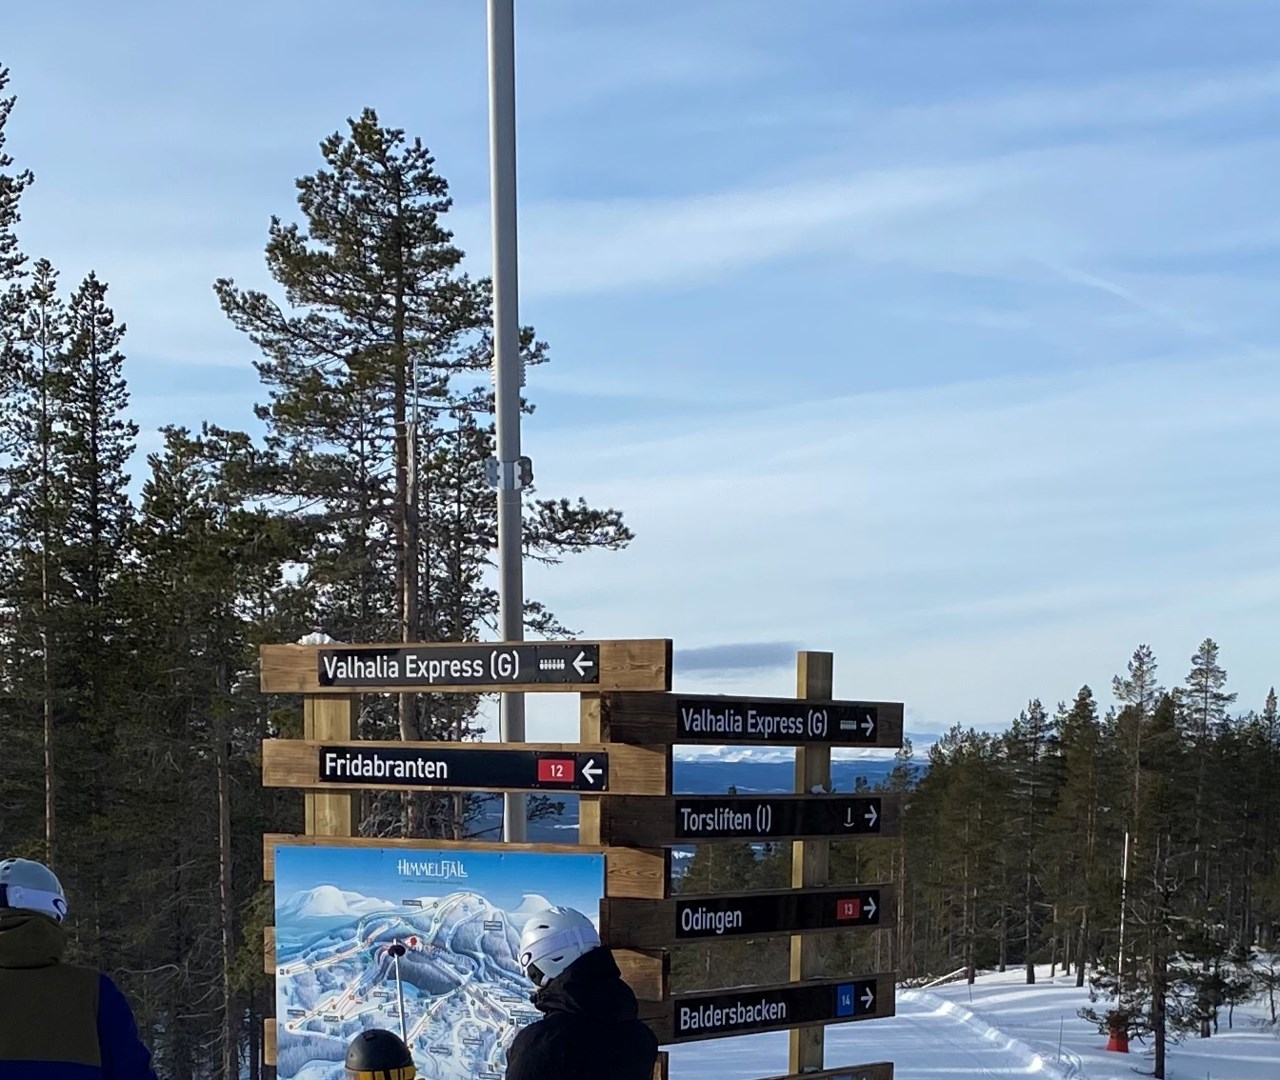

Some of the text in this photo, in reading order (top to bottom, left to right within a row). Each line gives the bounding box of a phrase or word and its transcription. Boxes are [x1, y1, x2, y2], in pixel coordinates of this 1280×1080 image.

[323, 650, 520, 684] Valhalia Express (G)
[681, 707, 828, 739] Valhalia Express (G)
[325, 752, 564, 779] Fridabranten 12
[680, 807, 752, 831] Torsliften
[681, 903, 853, 935] Odingen 13
[680, 999, 787, 1030] Baldersbacken
